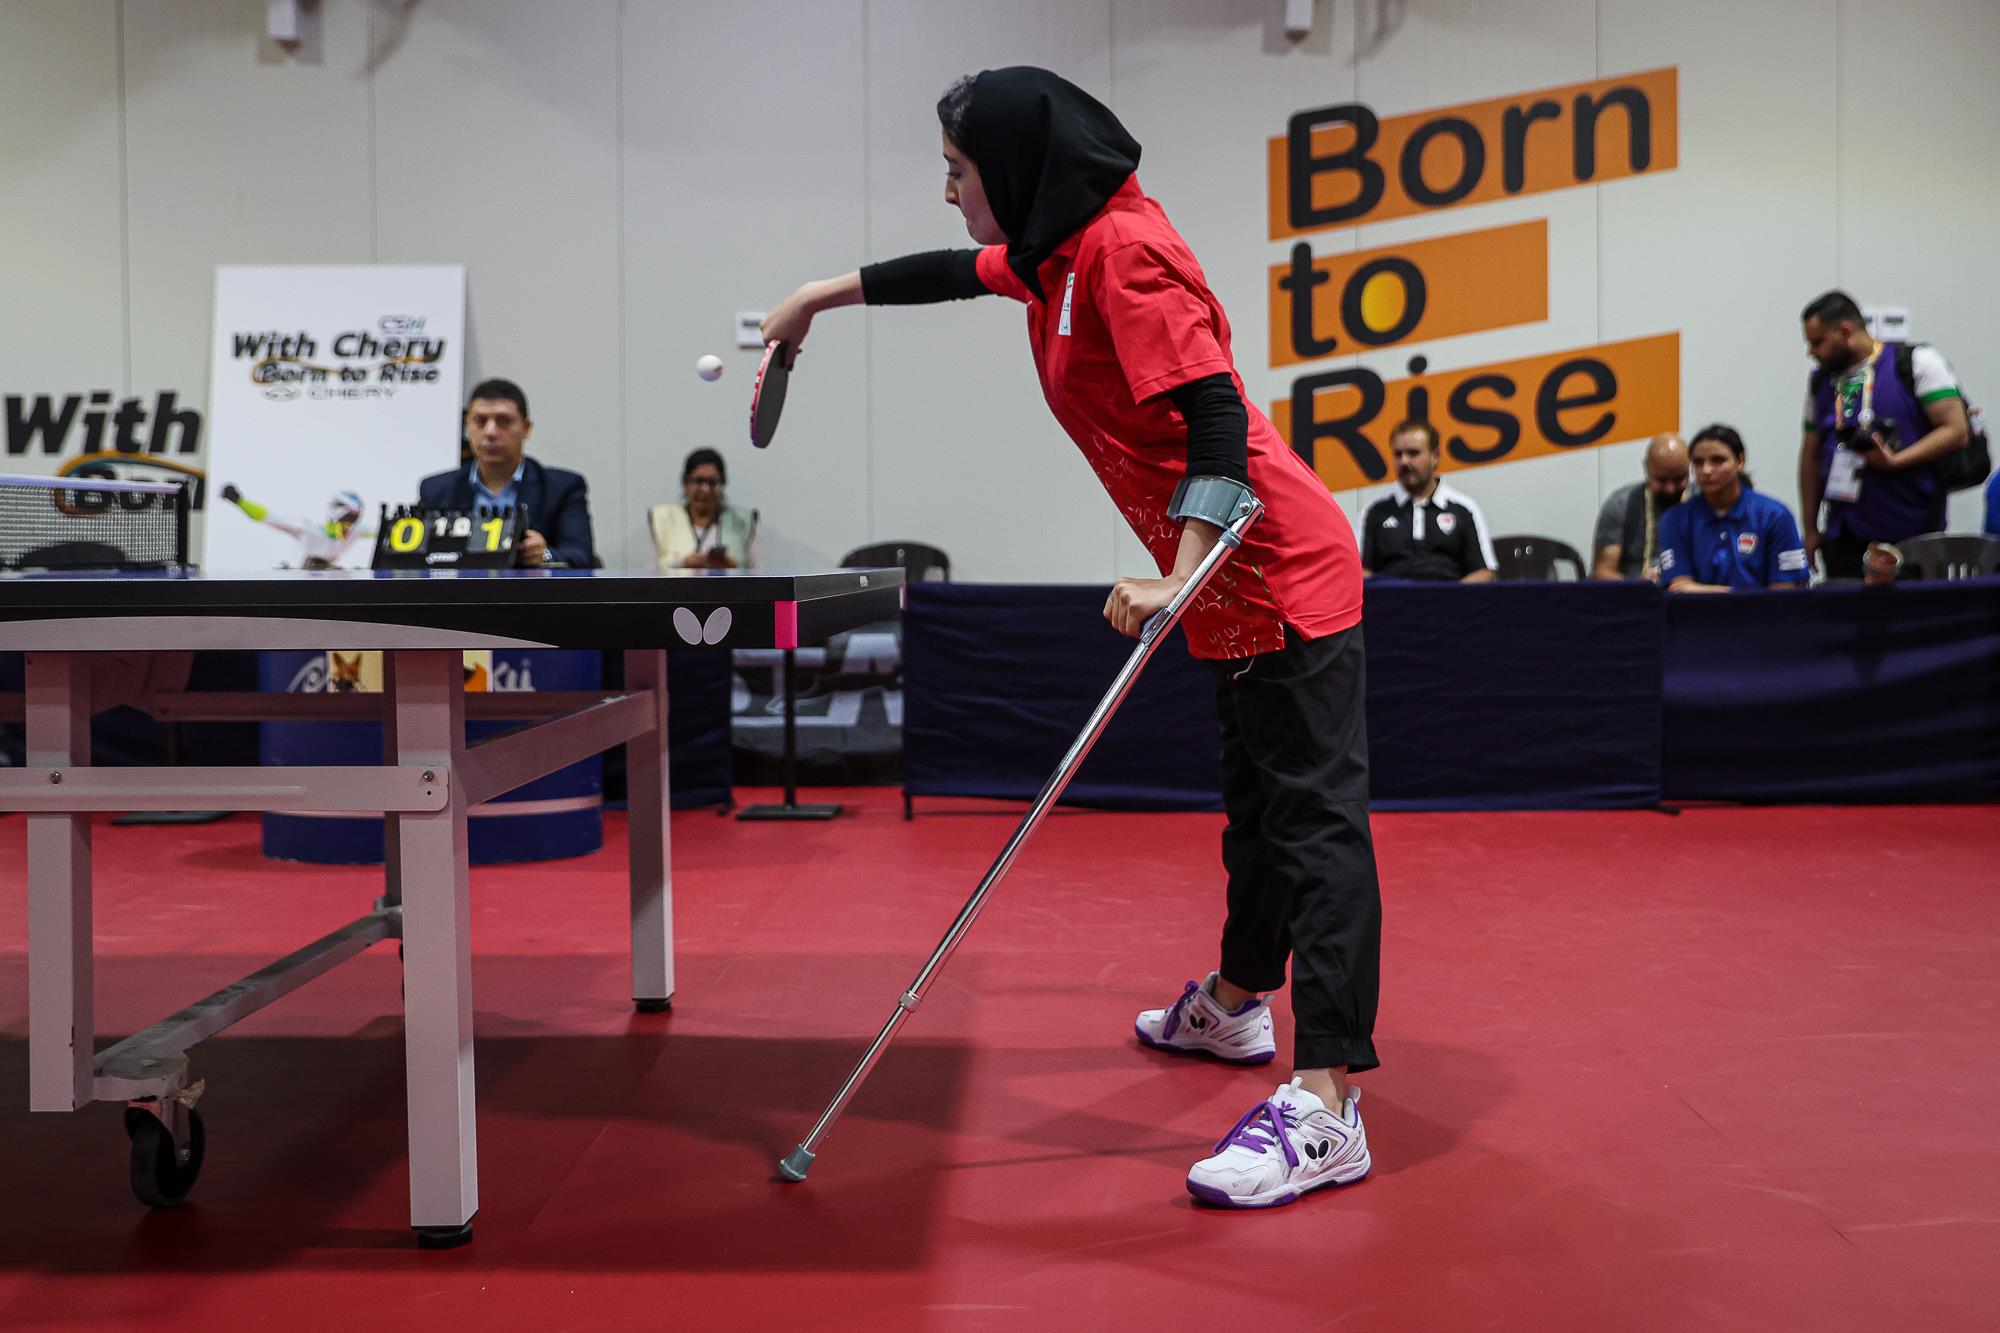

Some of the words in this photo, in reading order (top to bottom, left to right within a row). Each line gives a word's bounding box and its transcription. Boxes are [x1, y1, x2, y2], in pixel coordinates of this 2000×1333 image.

[1288, 85, 1651, 230] Born
[1278, 241, 1428, 358] to
[233, 331, 315, 359] With
[333, 332, 446, 363] Chery
[341, 366, 367, 384] to
[379, 362, 441, 384] Rise
[5, 391, 202, 455] With
[1291, 353, 1619, 482] Rise
[390, 517, 425, 553] 0
[480, 517, 504, 552] 1
